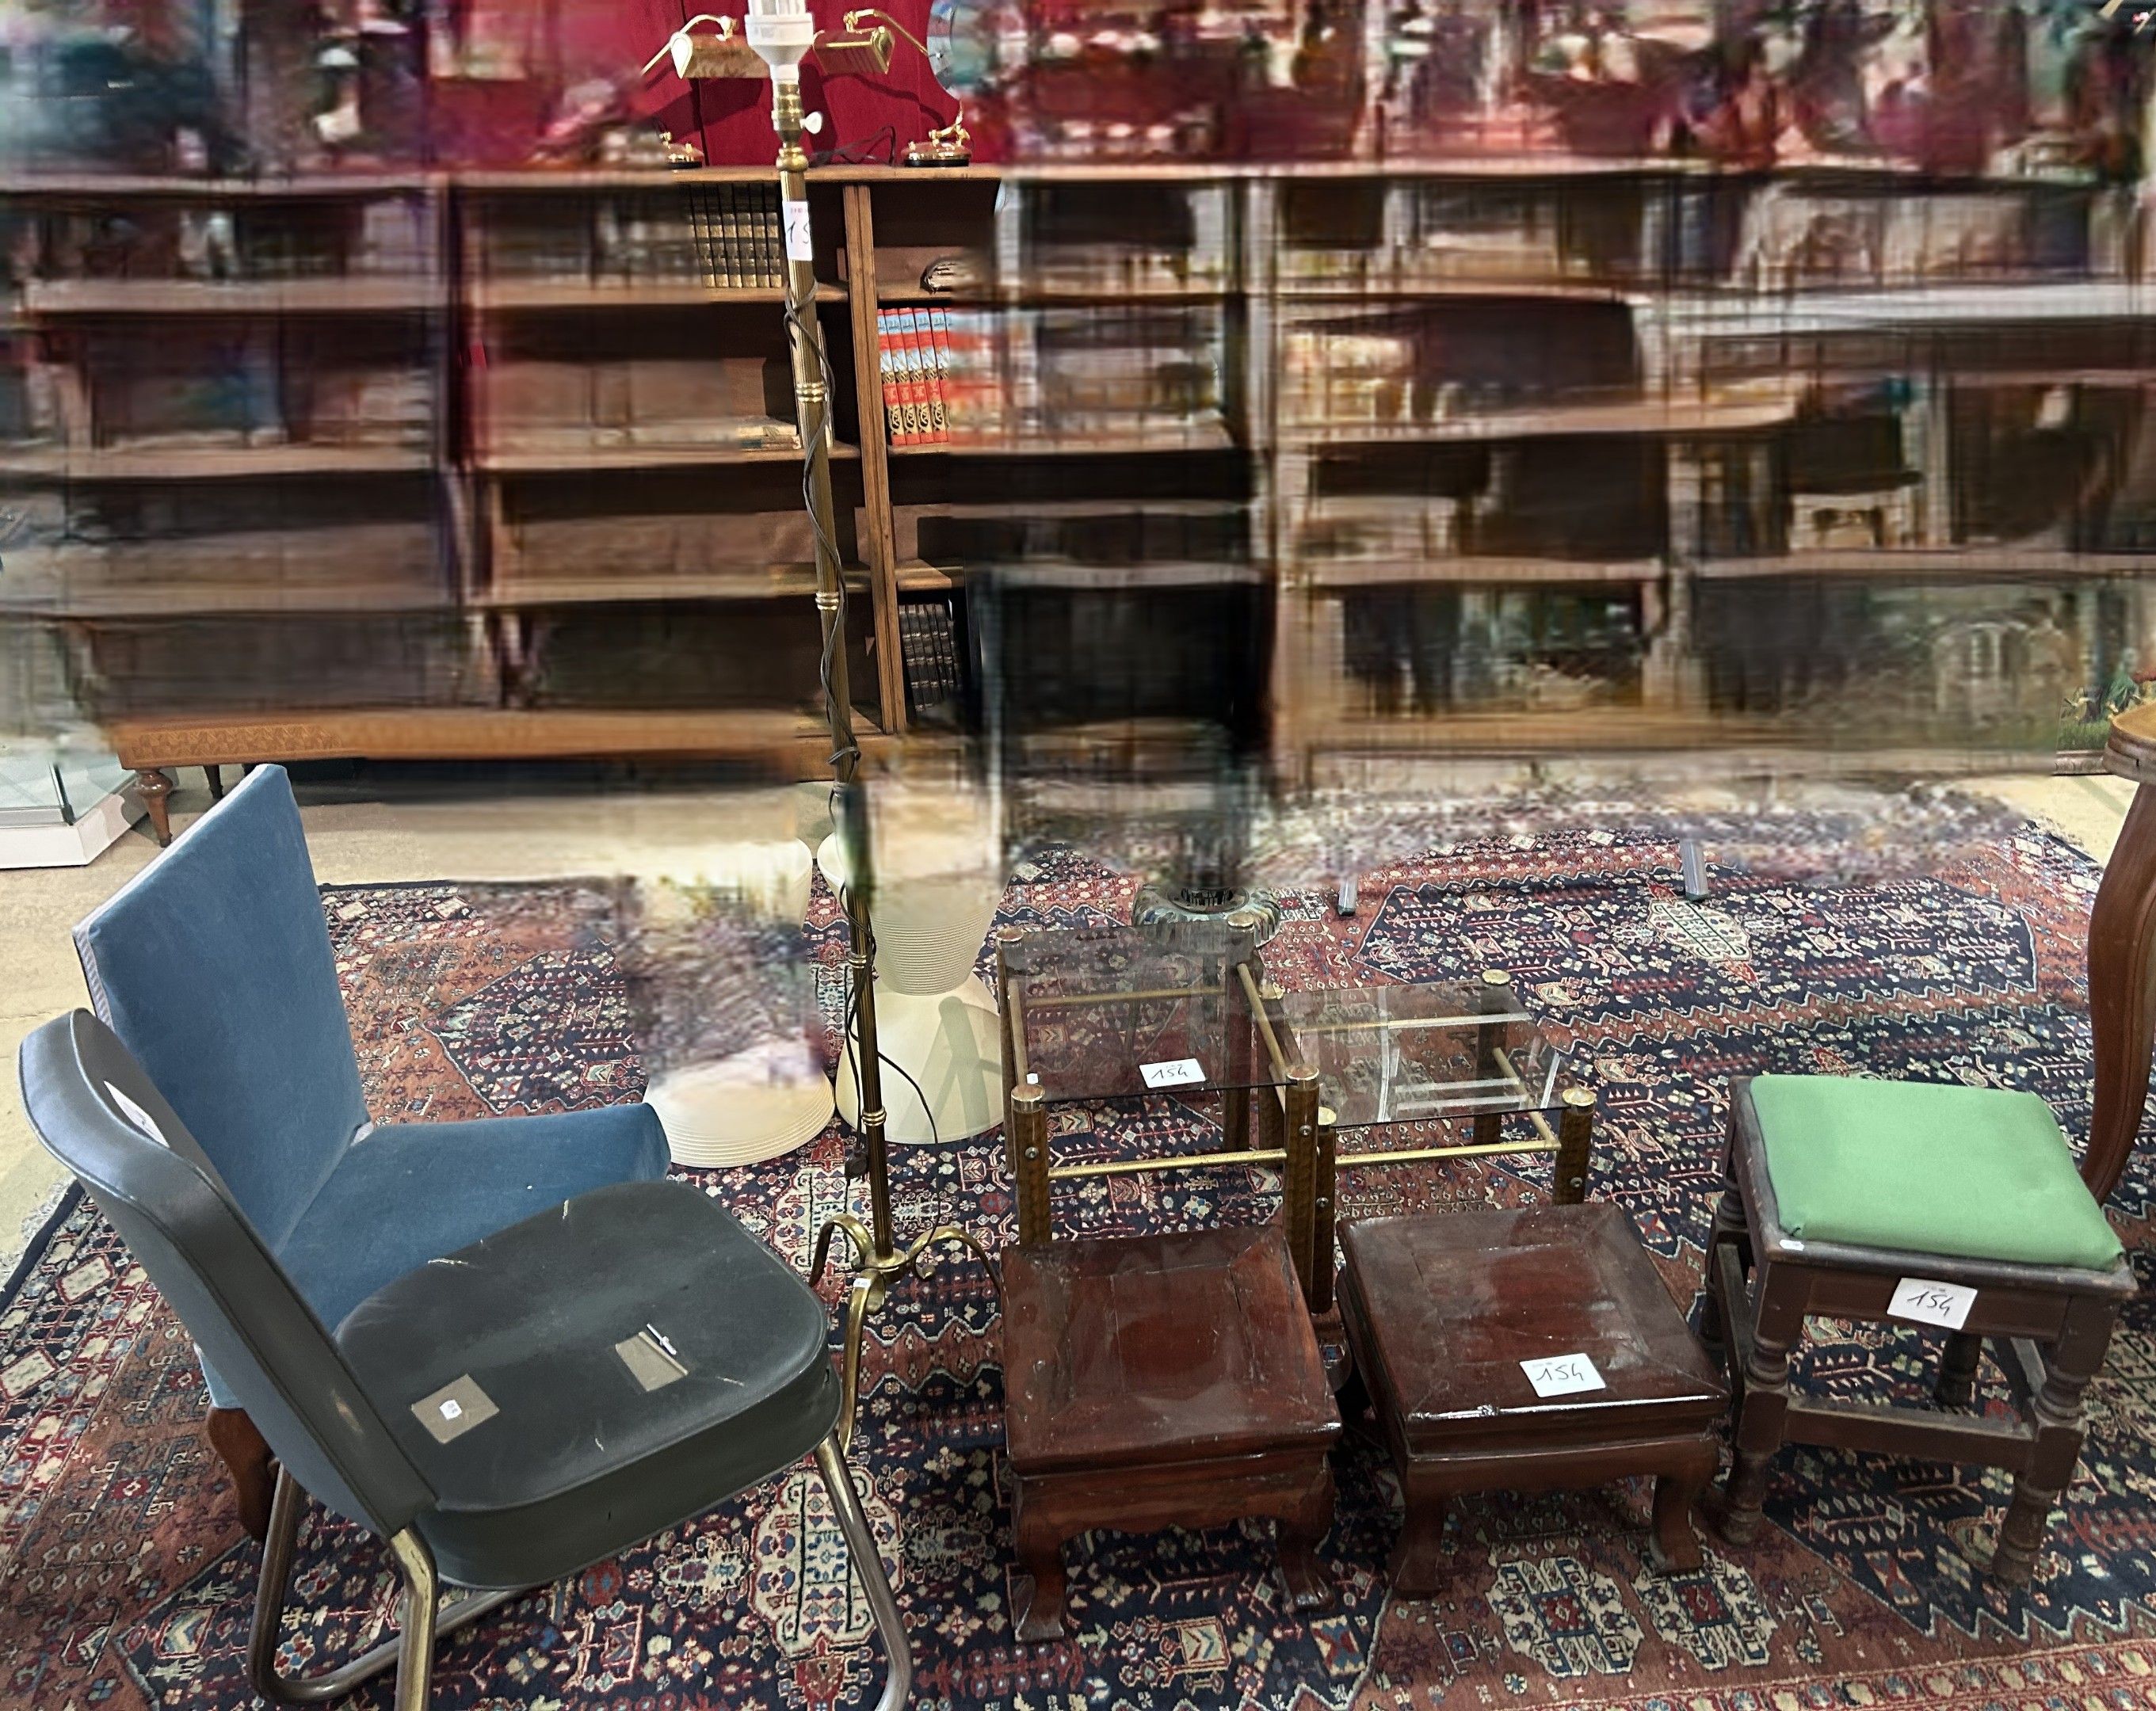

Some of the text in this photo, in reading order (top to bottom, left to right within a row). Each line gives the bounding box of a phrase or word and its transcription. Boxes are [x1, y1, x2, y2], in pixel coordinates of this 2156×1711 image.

[1151, 1064, 1189, 1079] 154
[1907, 1290, 1954, 1317] 154
[1536, 1362, 1584, 1381] 154
